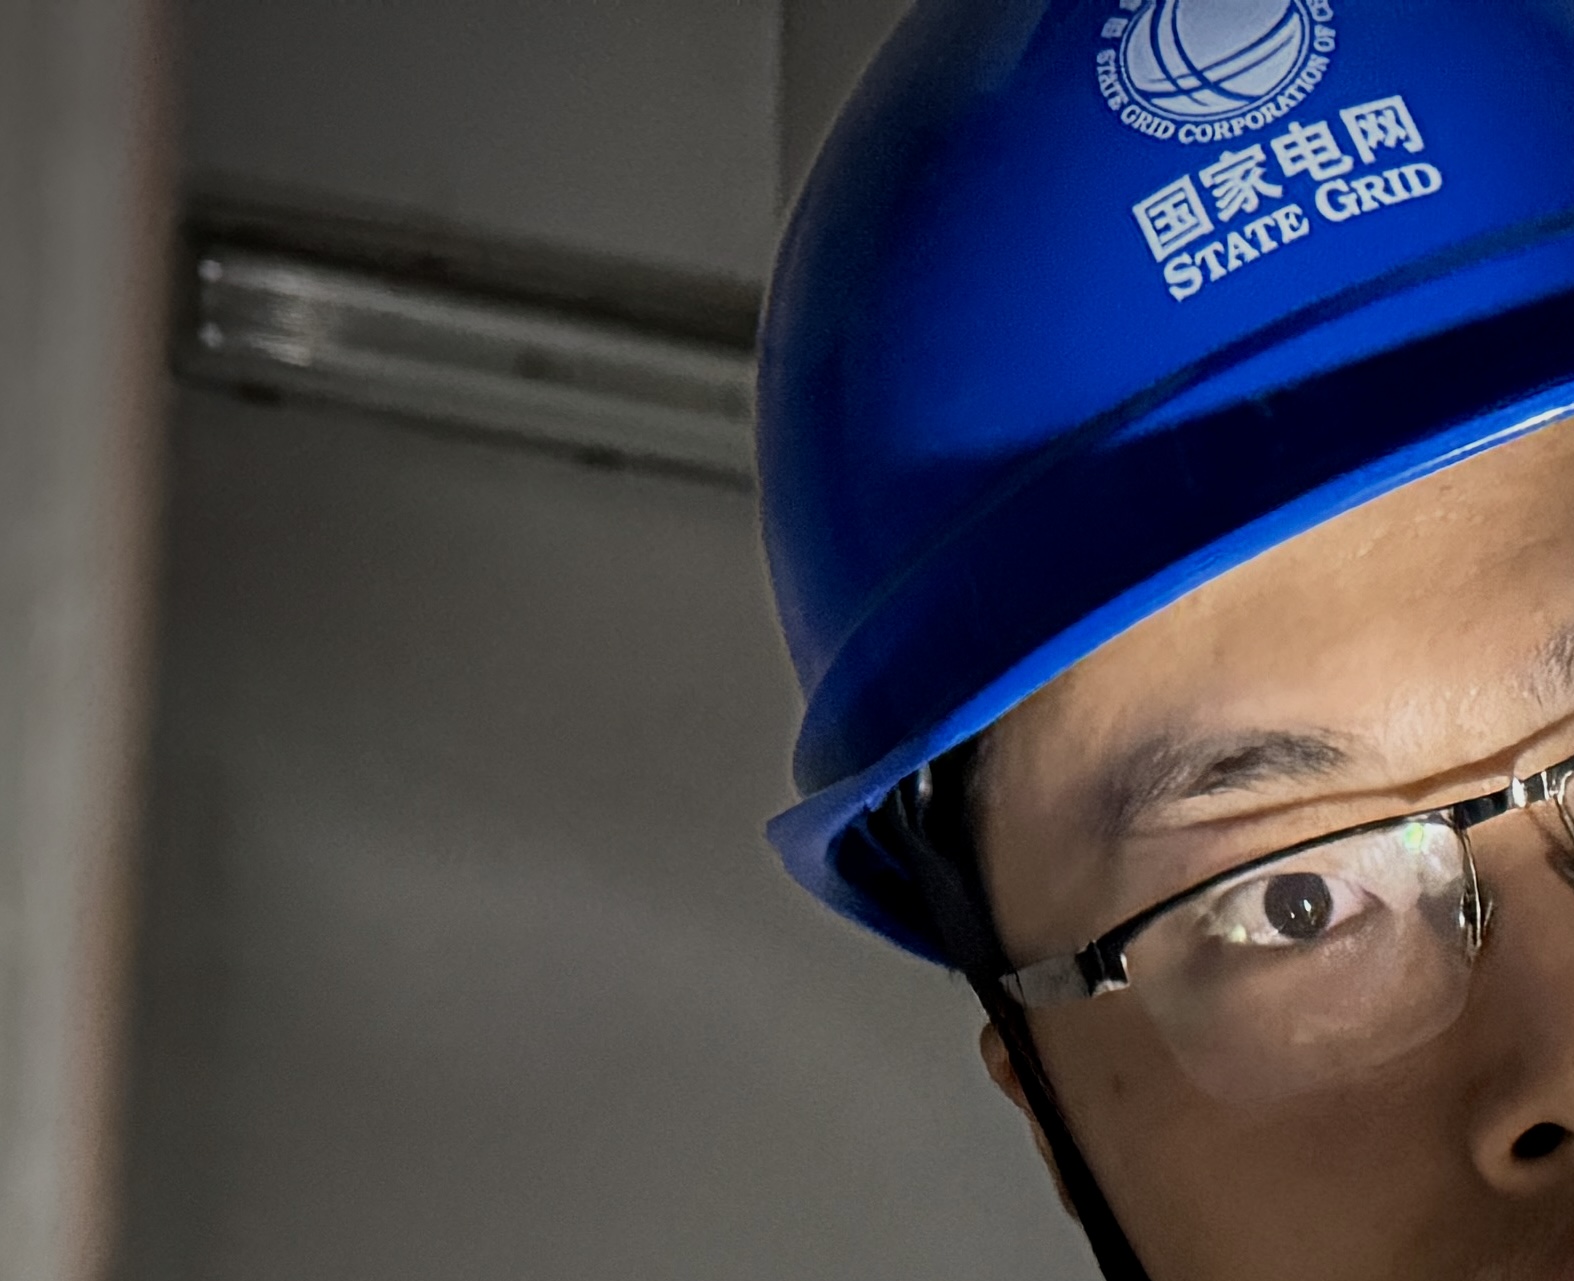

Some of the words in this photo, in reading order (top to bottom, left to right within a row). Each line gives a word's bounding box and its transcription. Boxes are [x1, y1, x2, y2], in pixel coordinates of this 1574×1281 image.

[1097, 48, 1129, 110] STATE
[1120, 104, 1176, 139] GRID
[1178, 54, 1331, 144] CORPORATION
[1313, 24, 1336, 52] OF
[1132, 95, 1424, 262] 国家电网
[1163, 204, 1310, 301] STATE
[1315, 162, 1442, 222] GRID
